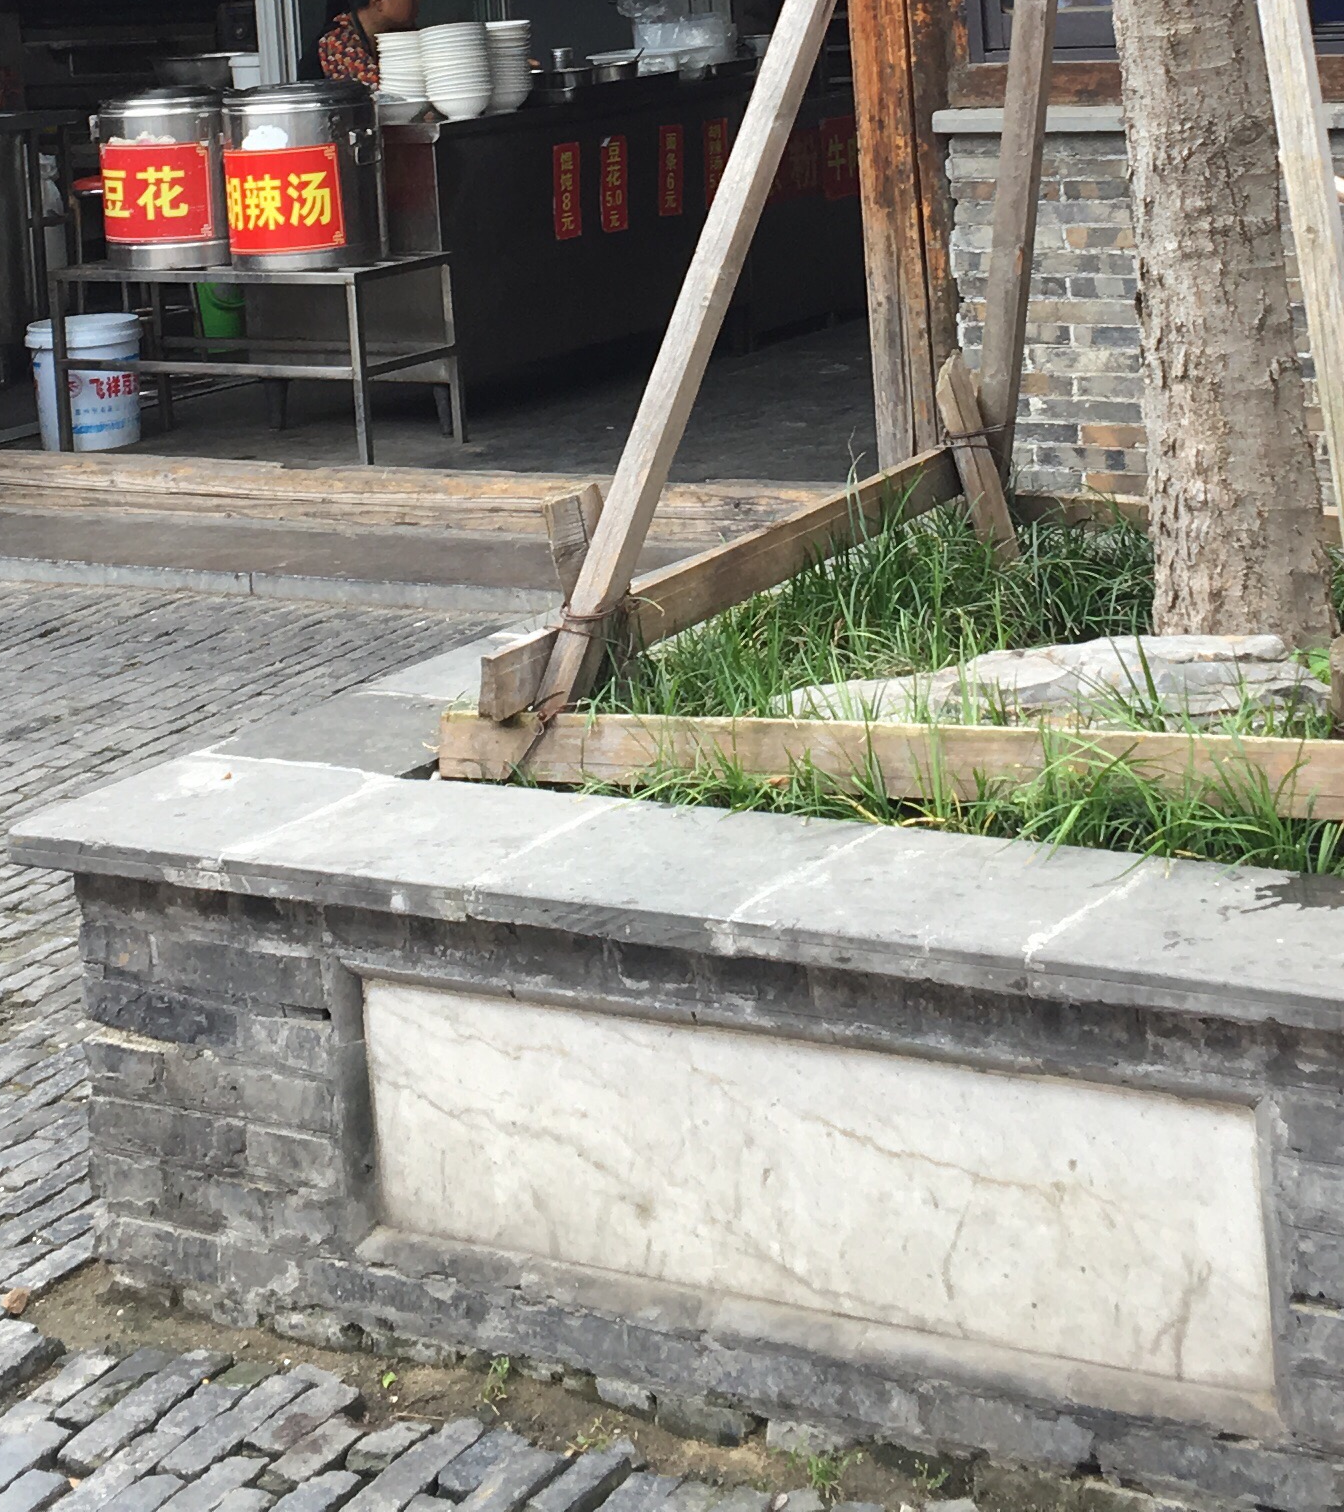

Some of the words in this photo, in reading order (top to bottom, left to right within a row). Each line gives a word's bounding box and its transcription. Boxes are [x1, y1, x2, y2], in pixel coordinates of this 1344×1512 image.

[102, 165, 189, 221] 豆花
[560, 151, 576, 232] 馄饨8元
[606, 141, 623, 228] 豆花5.0元
